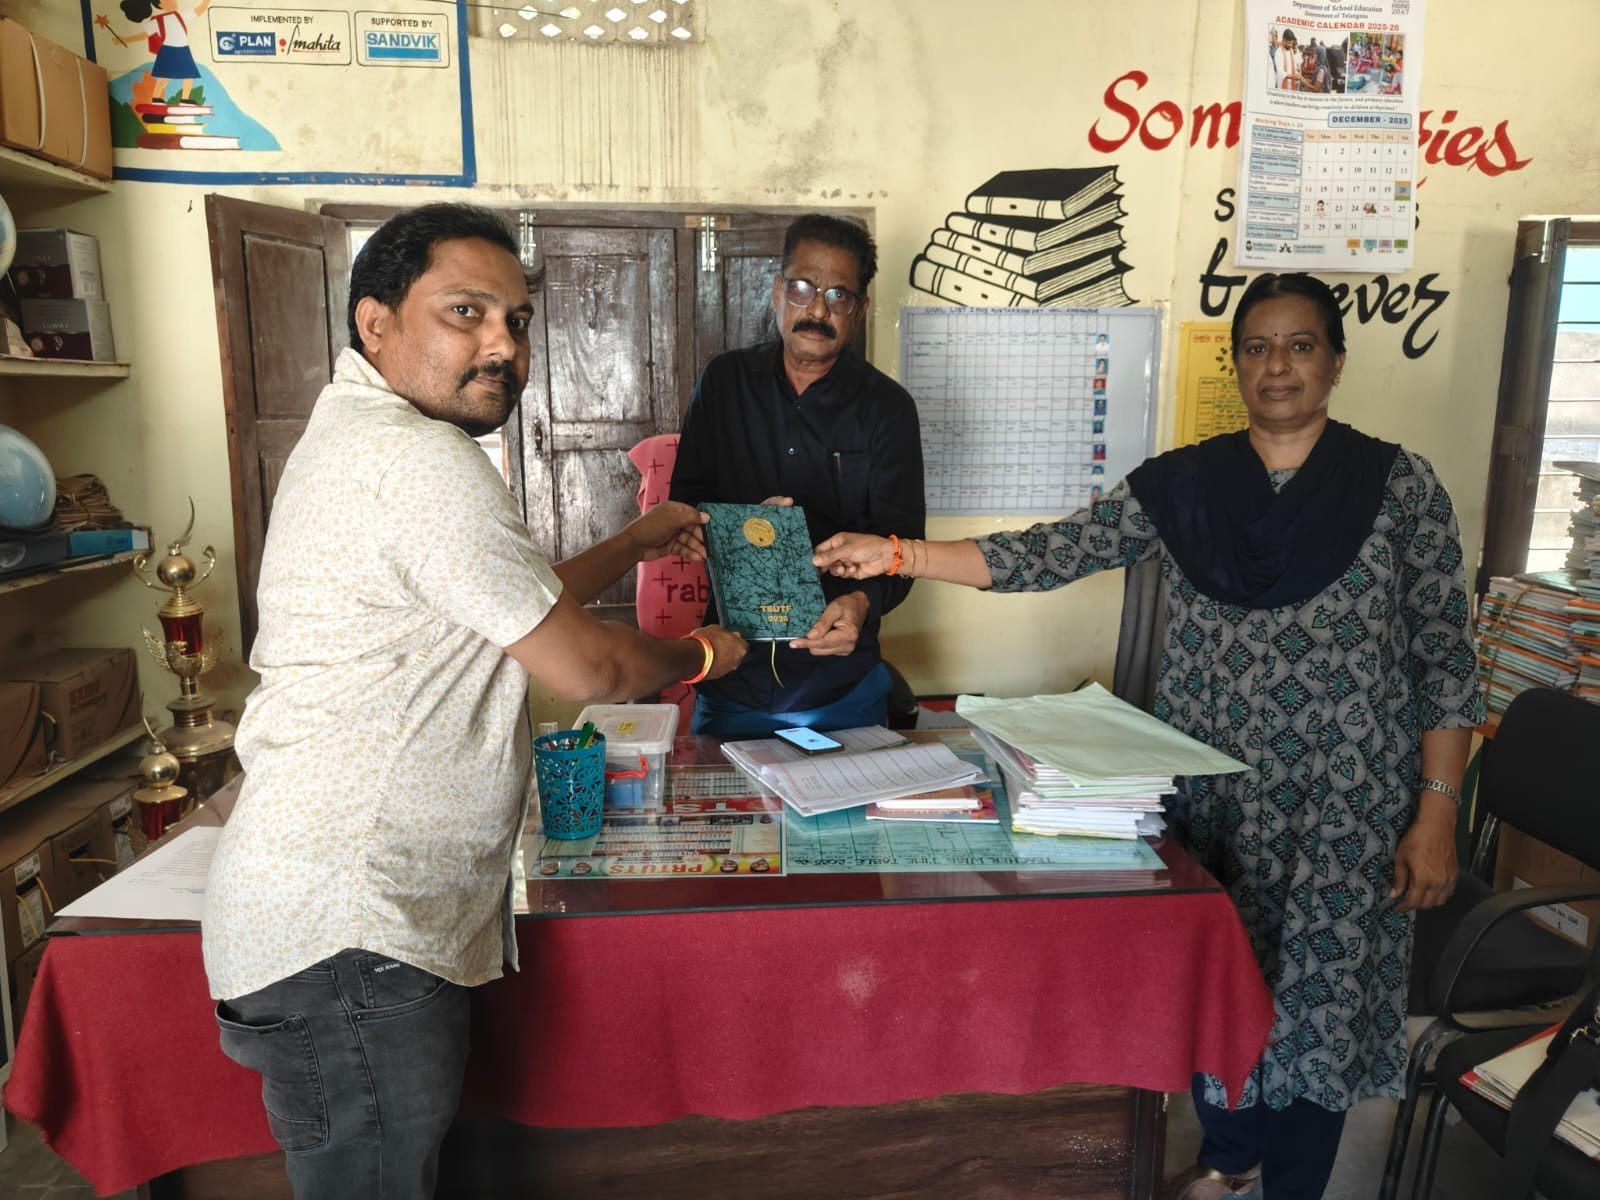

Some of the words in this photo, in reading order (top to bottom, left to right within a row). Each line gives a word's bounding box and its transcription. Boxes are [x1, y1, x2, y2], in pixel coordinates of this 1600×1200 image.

[1292, 0, 1320, 11] Department
[251, 15, 302, 24] IMPLEMENTED
[304, 16, 313, 24] BY
[371, 18, 419, 27] SUPPORTED
[421, 20, 432, 28] BY
[1275, 16, 1314, 28] ACADEMIC
[1317, 21, 1365, 29] CALENDAR
[1368, 23, 1400, 31] 2025-26
[238, 35, 272, 47] PLAN
[292, 33, 341, 51] mahita
[366, 33, 438, 48] SANDVIK
[1087, 69, 1241, 154] Som
